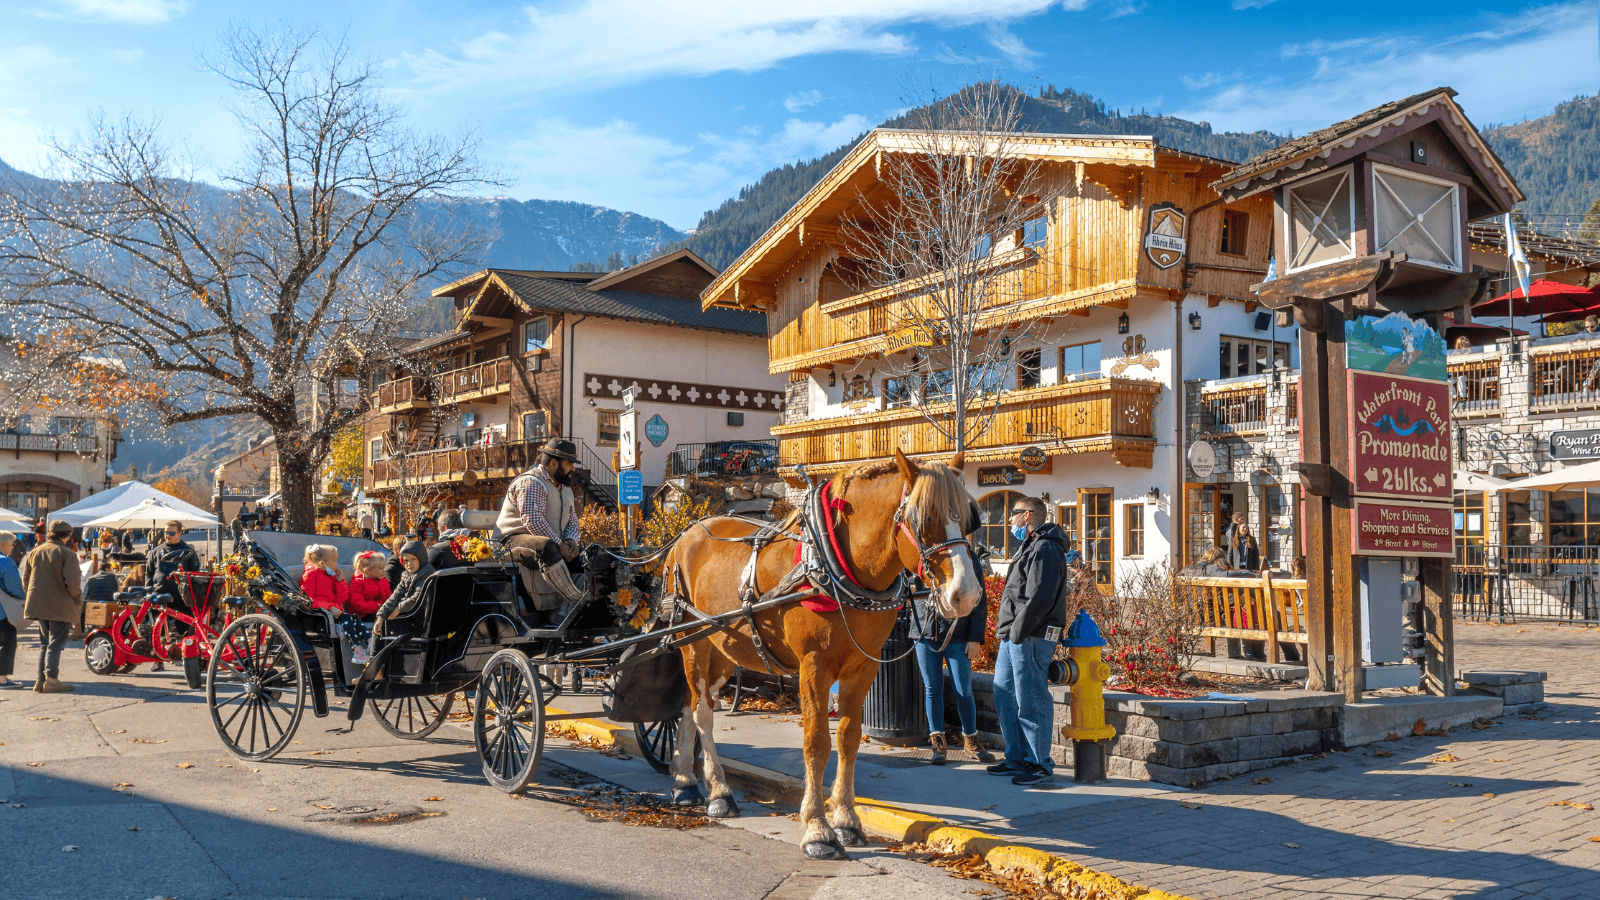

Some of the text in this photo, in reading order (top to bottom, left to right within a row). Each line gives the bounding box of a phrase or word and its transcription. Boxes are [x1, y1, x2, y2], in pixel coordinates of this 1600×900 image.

[1152, 235, 1168, 248] Rhein
[887, 333, 913, 351] Rhein
[1357, 381, 1448, 437] Waterfront Park
[1357, 430, 1448, 462] Promenade
[1556, 436, 1589, 449] Ryan
[1570, 447, 1592, 455] Wine
[982, 473, 1011, 485] BOOK
[1380, 508, 1431, 524] More Dining,
[1361, 520, 1449, 535] Shopping and Services
[1374, 538, 1438, 549] 8th Street & 9th Street
